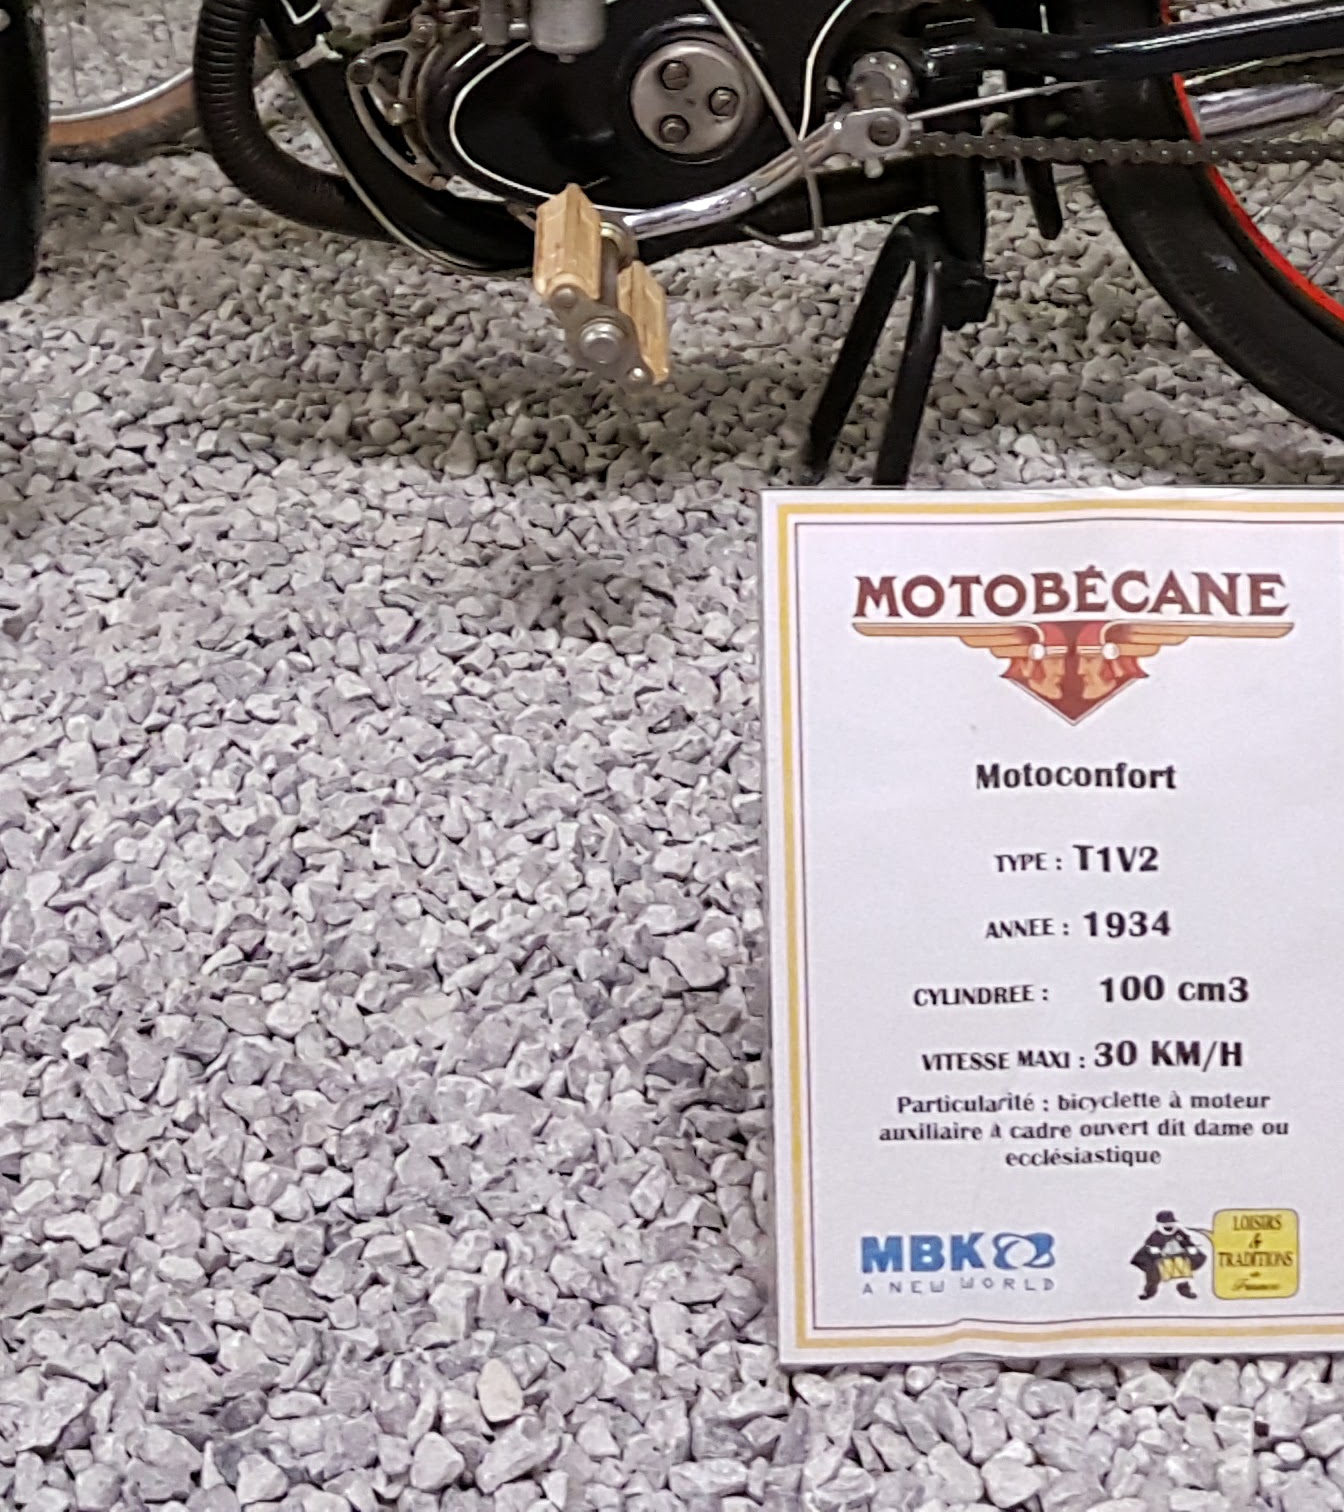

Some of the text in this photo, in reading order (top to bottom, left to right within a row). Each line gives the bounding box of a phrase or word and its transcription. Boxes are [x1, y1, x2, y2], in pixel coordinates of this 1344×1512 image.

[852, 564, 1289, 618] MOTOBÉCANE
[976, 762, 1177, 790] Motoconfort
[1072, 844, 1159, 873] T1V2
[1083, 910, 1171, 939] 1934
[1100, 974, 1165, 1003] 100
[1177, 976, 1249, 1003] cm3
[921, 1052, 1009, 1071] VITESSE
[1094, 1040, 1138, 1068] 30
[1151, 1040, 1242, 1073] KM/H
[1057, 1091, 1161, 1111] bicyclette
[1168, 1090, 1182, 1110] à
[1190, 1092, 1271, 1109] moteur
[879, 1122, 983, 1141] auxiliaire
[1009, 1122, 1072, 1139] cadre
[1079, 1120, 1149, 1137] ouvert
[1157, 1118, 1186, 1137] dit
[1194, 1118, 1254, 1137] dame
[1261, 1121, 1289, 1136] ou
[1005, 1145, 1161, 1168] ecclésiastique
[861, 1232, 986, 1274] MBK
[1218, 1251, 1293, 1267] TRADITIONS
[862, 1276, 1055, 1295] A NEW WORLD
